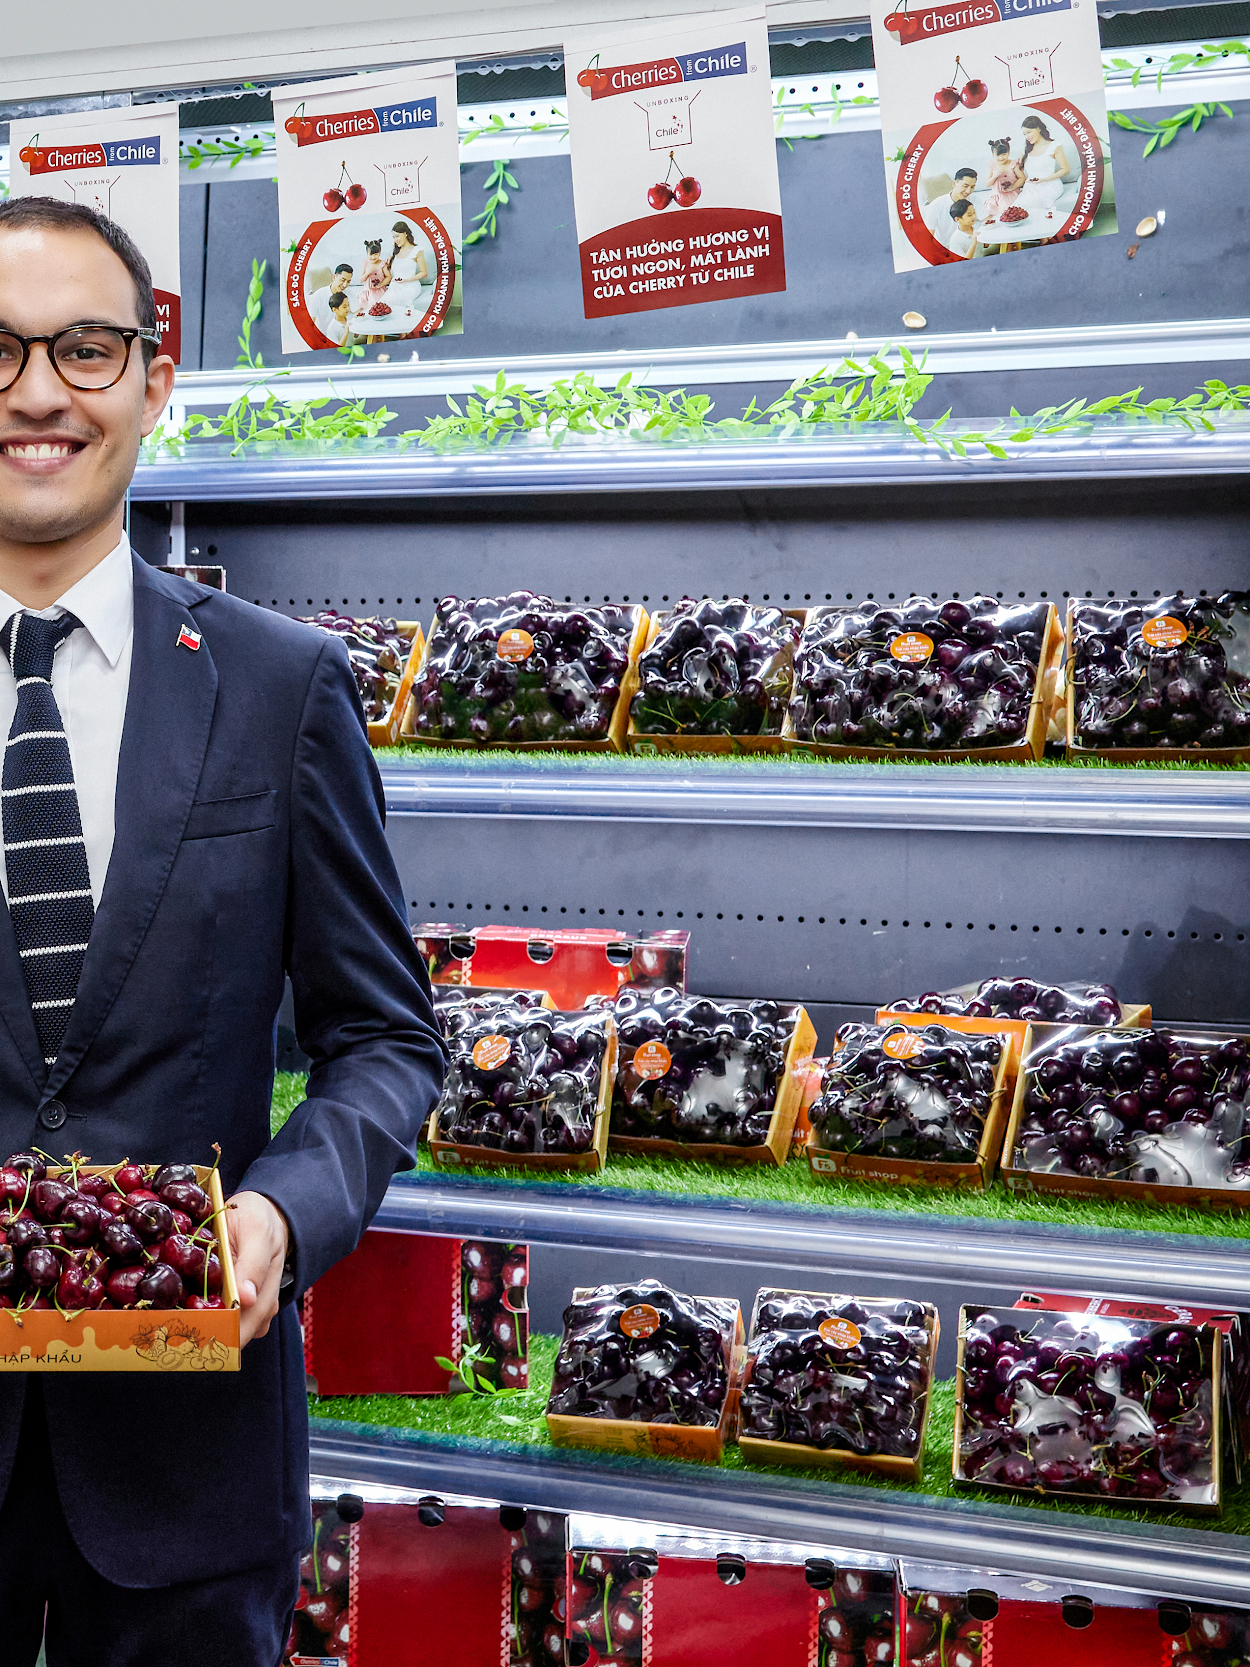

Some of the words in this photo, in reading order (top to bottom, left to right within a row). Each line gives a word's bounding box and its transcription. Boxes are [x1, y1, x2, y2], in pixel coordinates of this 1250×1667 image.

[922, 4, 994, 33] Cherries
[1006, 48, 1050, 61] UNBOXING
[611, 65, 677, 90] Cherries
[694, 53, 741, 74] Chile
[1017, 77, 1040, 88] Chile
[646, 95, 690, 108] UNBOXING
[316, 115, 374, 137] Cherries
[390, 106, 432, 126] Chile
[655, 126, 678, 138] Chile
[48, 148, 102, 168] Cherries
[116, 144, 156, 161] Chile
[384, 160, 418, 170] UNBOXING
[904, 144, 925, 182] CHERRY
[74, 178, 110, 186] UNBOXING
[390, 187, 410, 196] Chile
[1068, 214, 1085, 236] CHO
[1079, 170, 1096, 215] KHOẢNH
[294, 238, 312, 272] CHERRY
[590, 248, 622, 266] TẬN
[626, 238, 685, 260] HƯỞNG
[688, 229, 750, 250] HƯƠNG
[752, 226, 770, 241] VỊ
[592, 265, 628, 282] TƯƠI
[632, 258, 686, 276] NGON,
[690, 248, 723, 268] MÁT
[727, 244, 770, 262] LÀNH
[593, 282, 625, 300] CỦA
[628, 274, 686, 294] CHERRY
[690, 269, 710, 285] TỪ
[714, 264, 754, 282] CHILE
[156, 304, 170, 318] VỊ
[422, 315, 437, 333] CHO
[840, 1166, 865, 1176] Fruit
[868, 1170, 898, 1180] shop
[36, 1350, 82, 1363] KHẨU
